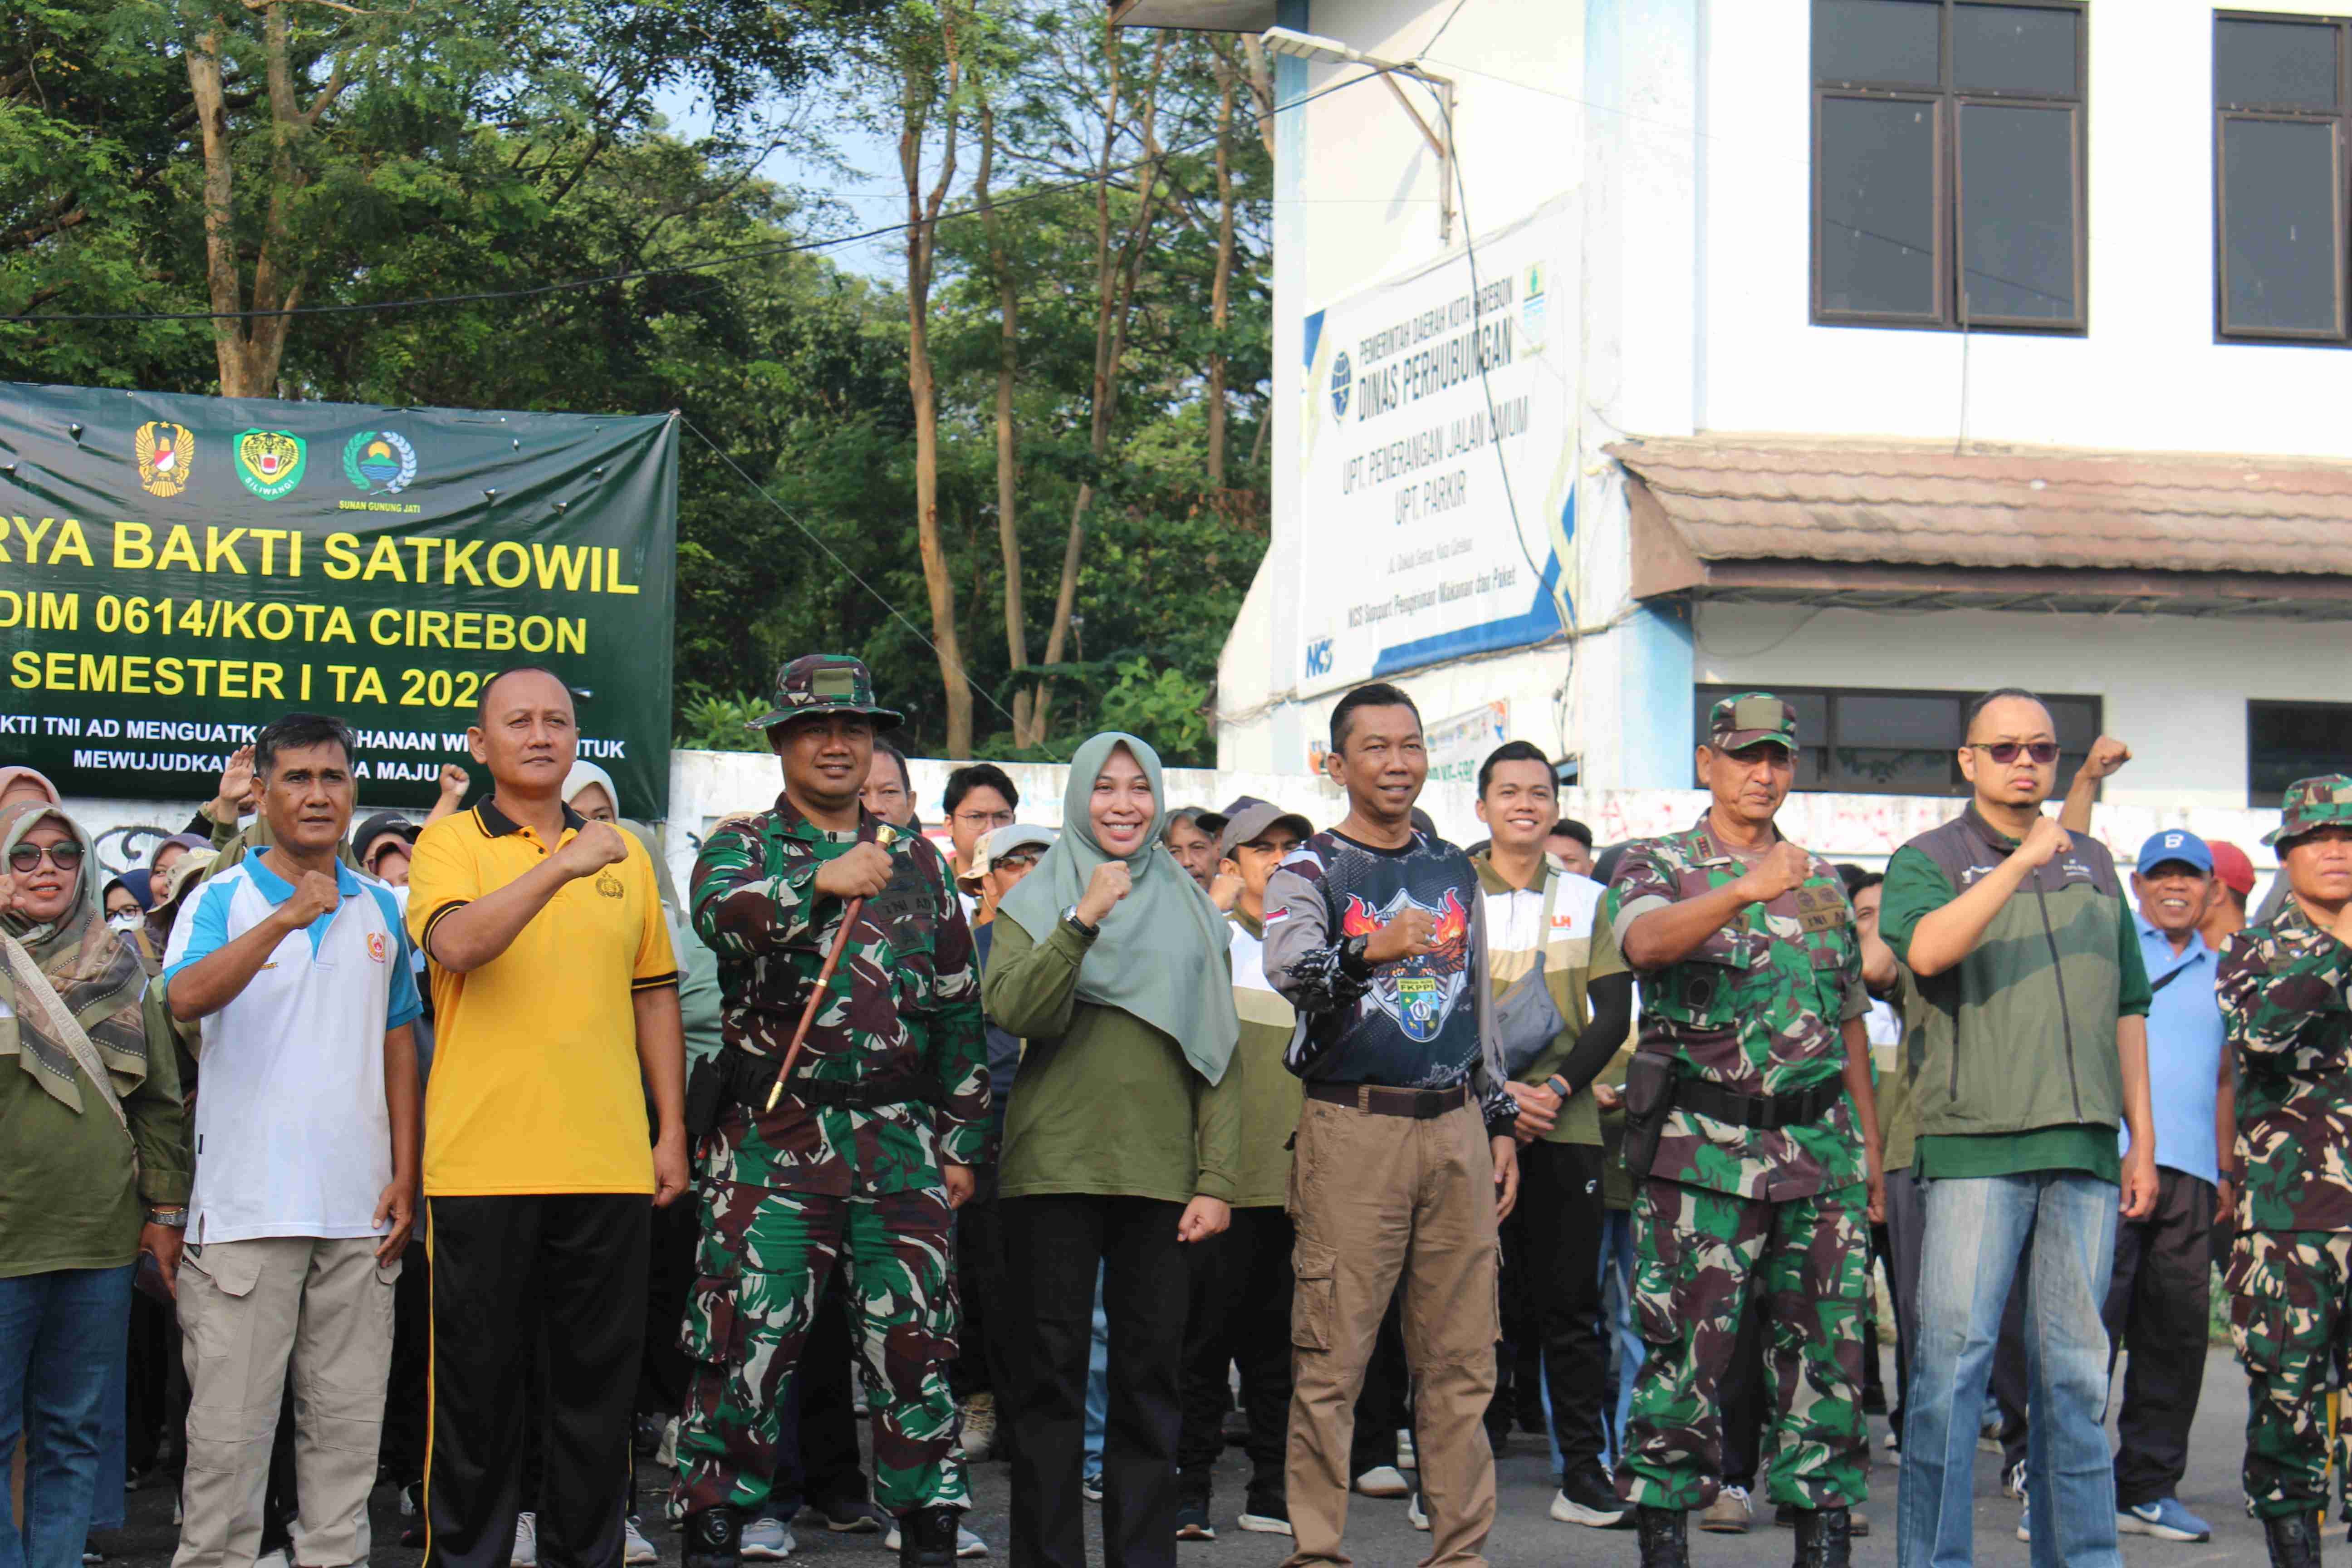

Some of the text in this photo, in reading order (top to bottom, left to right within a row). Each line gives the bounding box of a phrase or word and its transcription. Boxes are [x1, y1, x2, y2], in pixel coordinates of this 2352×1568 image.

[1359, 321, 1410, 368] PEMERINTAH
[1413, 304, 1446, 345] DAERAH
[1448, 294, 1470, 328] KOTA
[1358, 316, 1511, 422] DINAS PERHUBUNGAN
[1369, 425, 1443, 484] PENERANGAN
[1447, 411, 1485, 459] JALAN
[1489, 395, 1528, 443] UMUM
[245, 477, 294, 495] SILIWANGI
[339, 500, 421, 513] SUNAN GUNUNG JATI
[1424, 470, 1466, 516] PARKIR
[113, 521, 301, 577] BAKTI
[323, 532, 639, 594] SATKOWIL
[96, 595, 356, 643] 0614/KOTA
[369, 608, 586, 654] CIREBON
[11, 651, 499, 708] SEMESTER I TA 202
[0, 715, 37, 734] KTI
[44, 717, 80, 736] TNI
[86, 719, 119, 738] AD
[127, 720, 267, 743] MENGUATK
[349, 730, 436, 752] HANAN
[377, 762, 439, 782] MAJU
